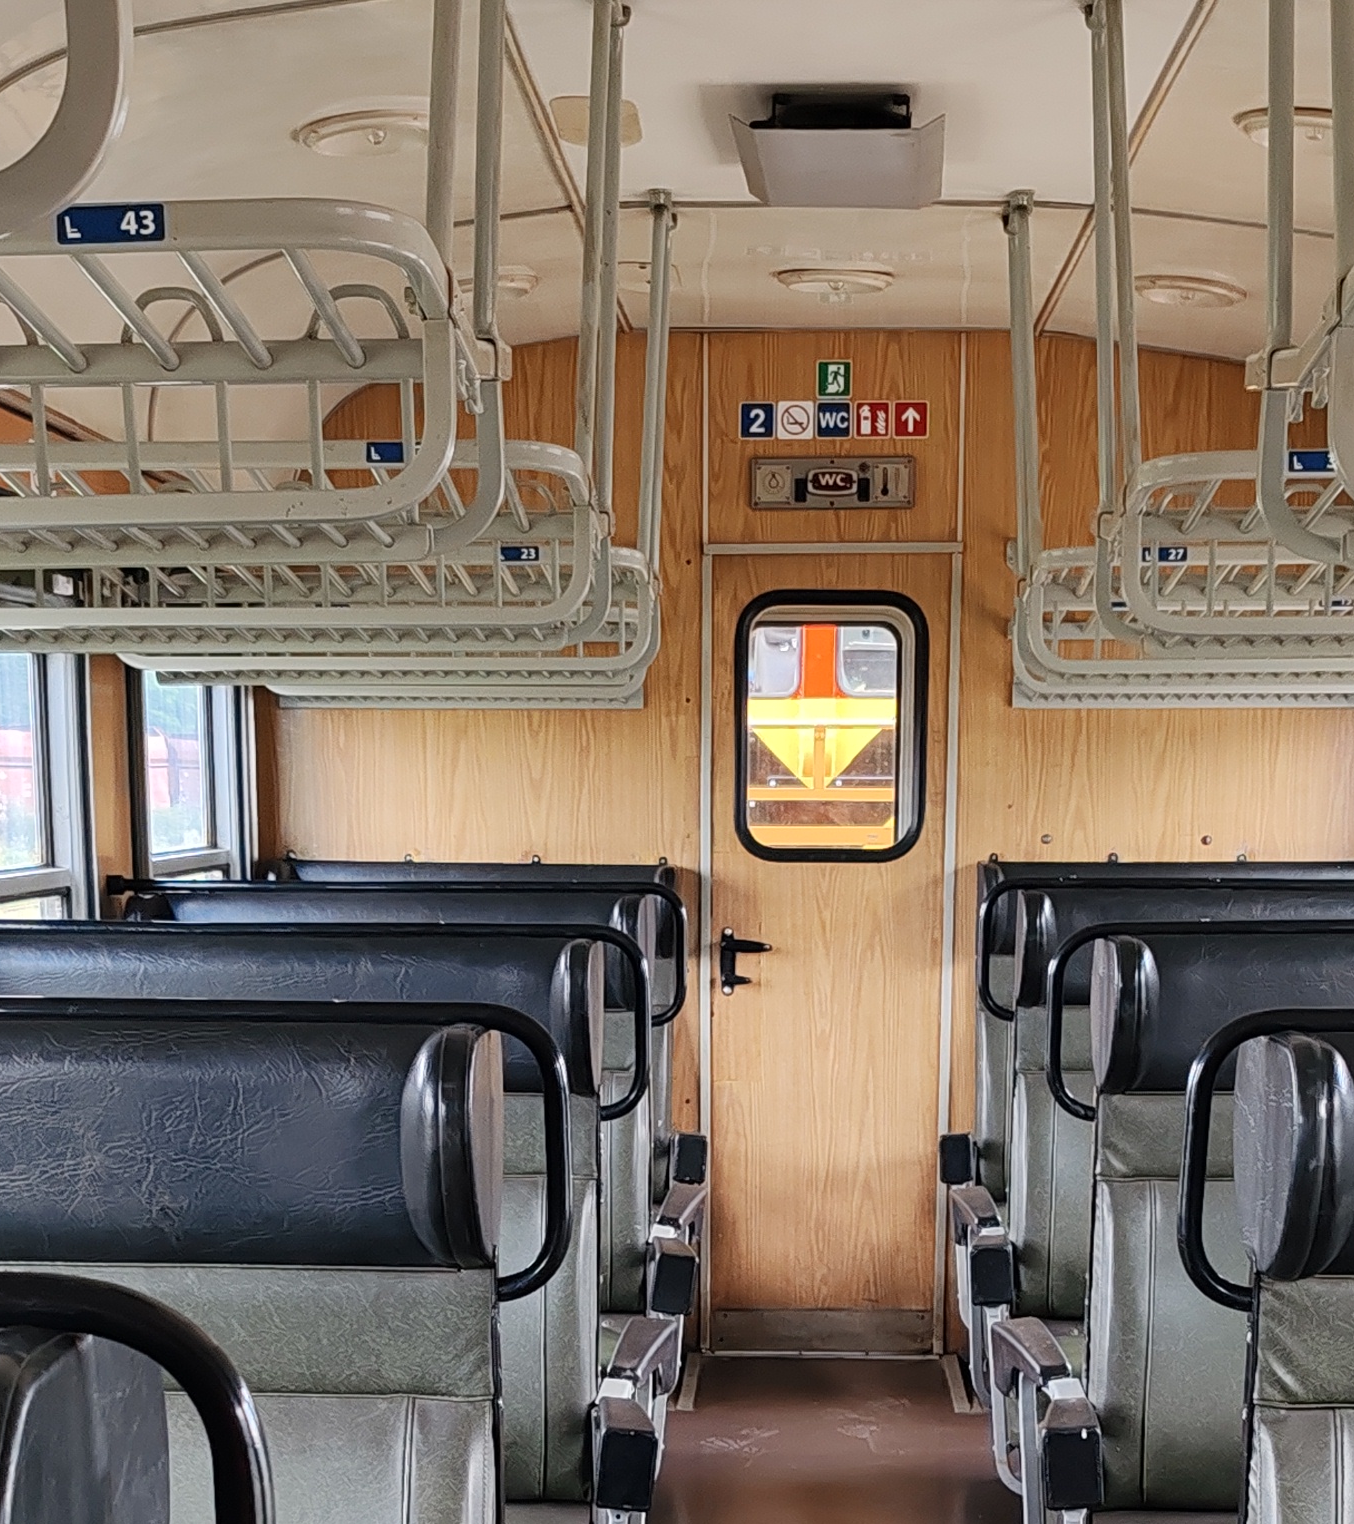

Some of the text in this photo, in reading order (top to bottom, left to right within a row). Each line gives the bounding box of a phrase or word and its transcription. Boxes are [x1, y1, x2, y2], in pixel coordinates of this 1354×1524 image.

[120, 210, 156, 235] 43
[749, 408, 766, 434] 2
[819, 411, 849, 429] WC
[818, 473, 846, 487] WC
[520, 548, 537, 560] 23
[1167, 548, 1185, 561] 27
